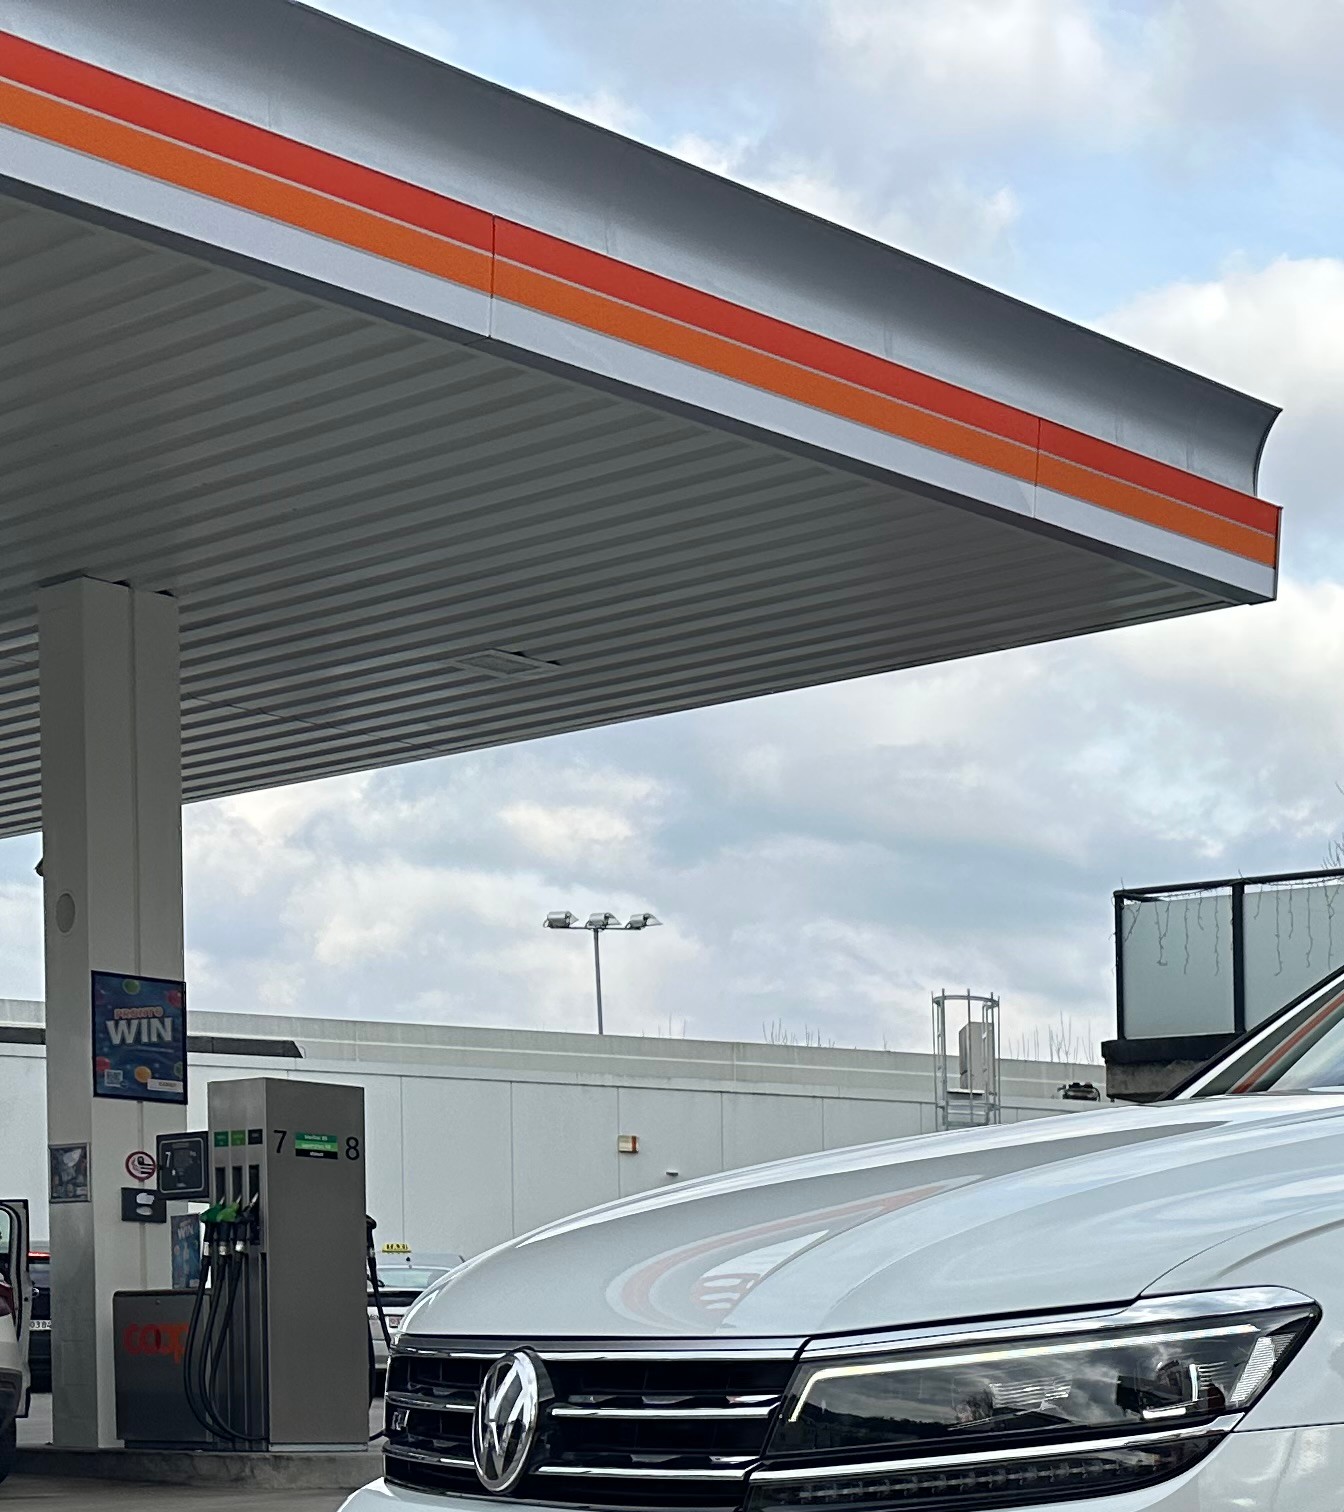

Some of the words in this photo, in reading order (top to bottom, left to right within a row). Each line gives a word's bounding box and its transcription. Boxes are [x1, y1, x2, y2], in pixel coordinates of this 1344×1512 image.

[106, 1017, 173, 1045] WIN
[273, 1129, 287, 1154] 7
[345, 1136, 360, 1161] 8
